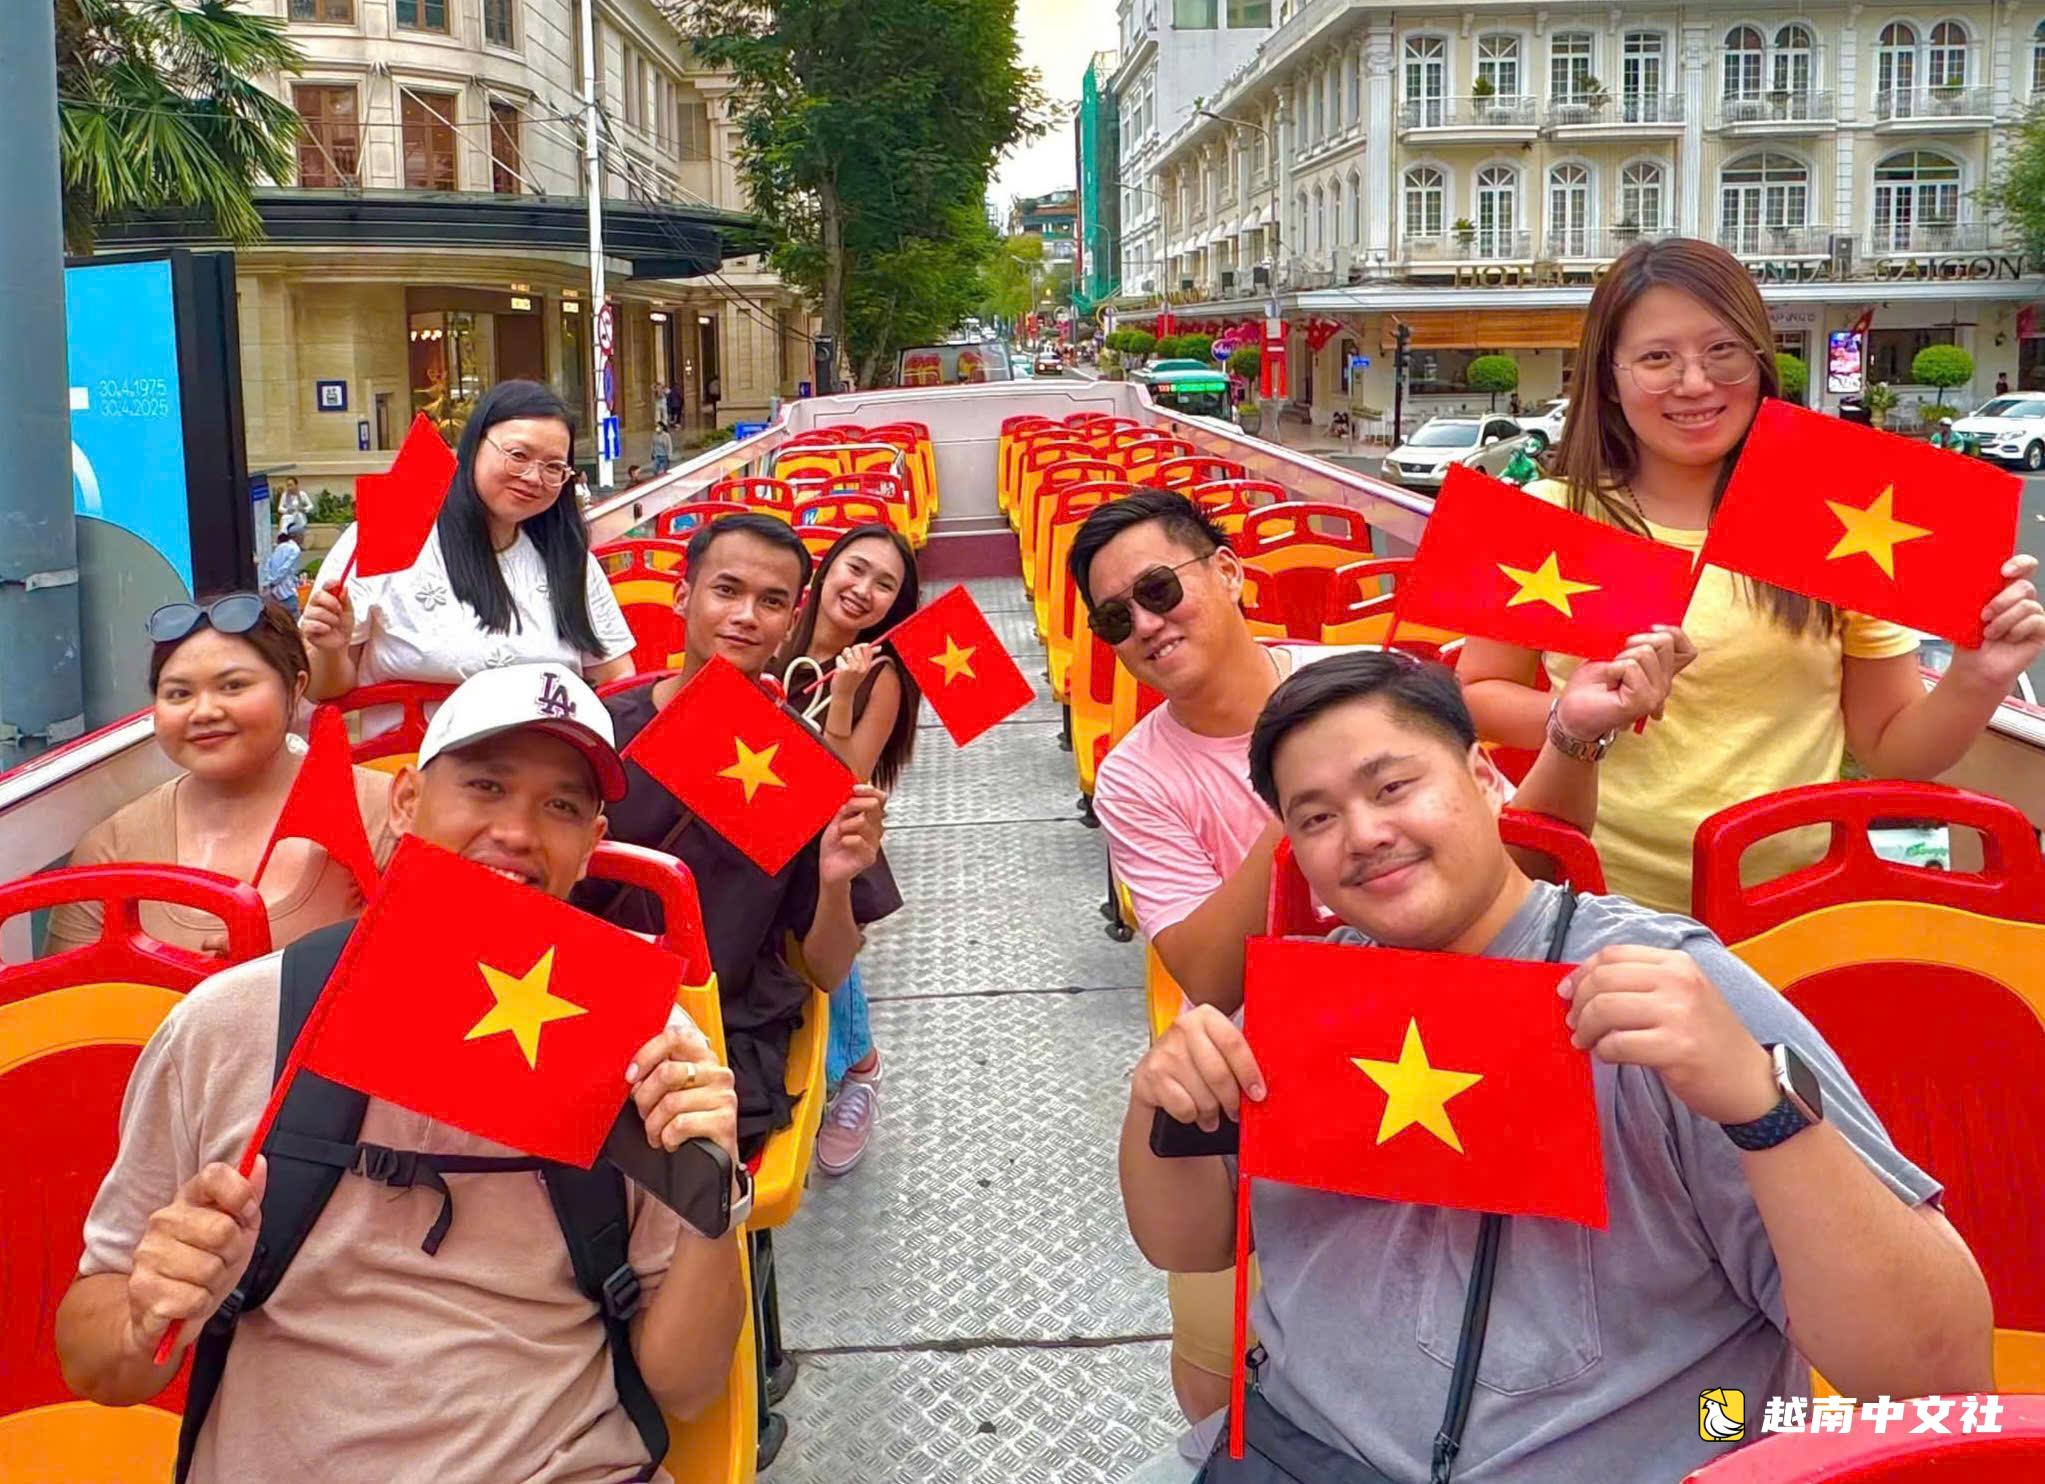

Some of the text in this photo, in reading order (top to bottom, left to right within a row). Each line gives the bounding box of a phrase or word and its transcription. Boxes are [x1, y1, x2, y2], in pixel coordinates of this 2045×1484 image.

[1455, 263, 1573, 288] HOTEL
[1874, 256, 2024, 282] SAIGON
[99, 378, 168, 398] 30.4.1975
[101, 399, 169, 416] 30.4.2025
[537, 671, 577, 719] LA
